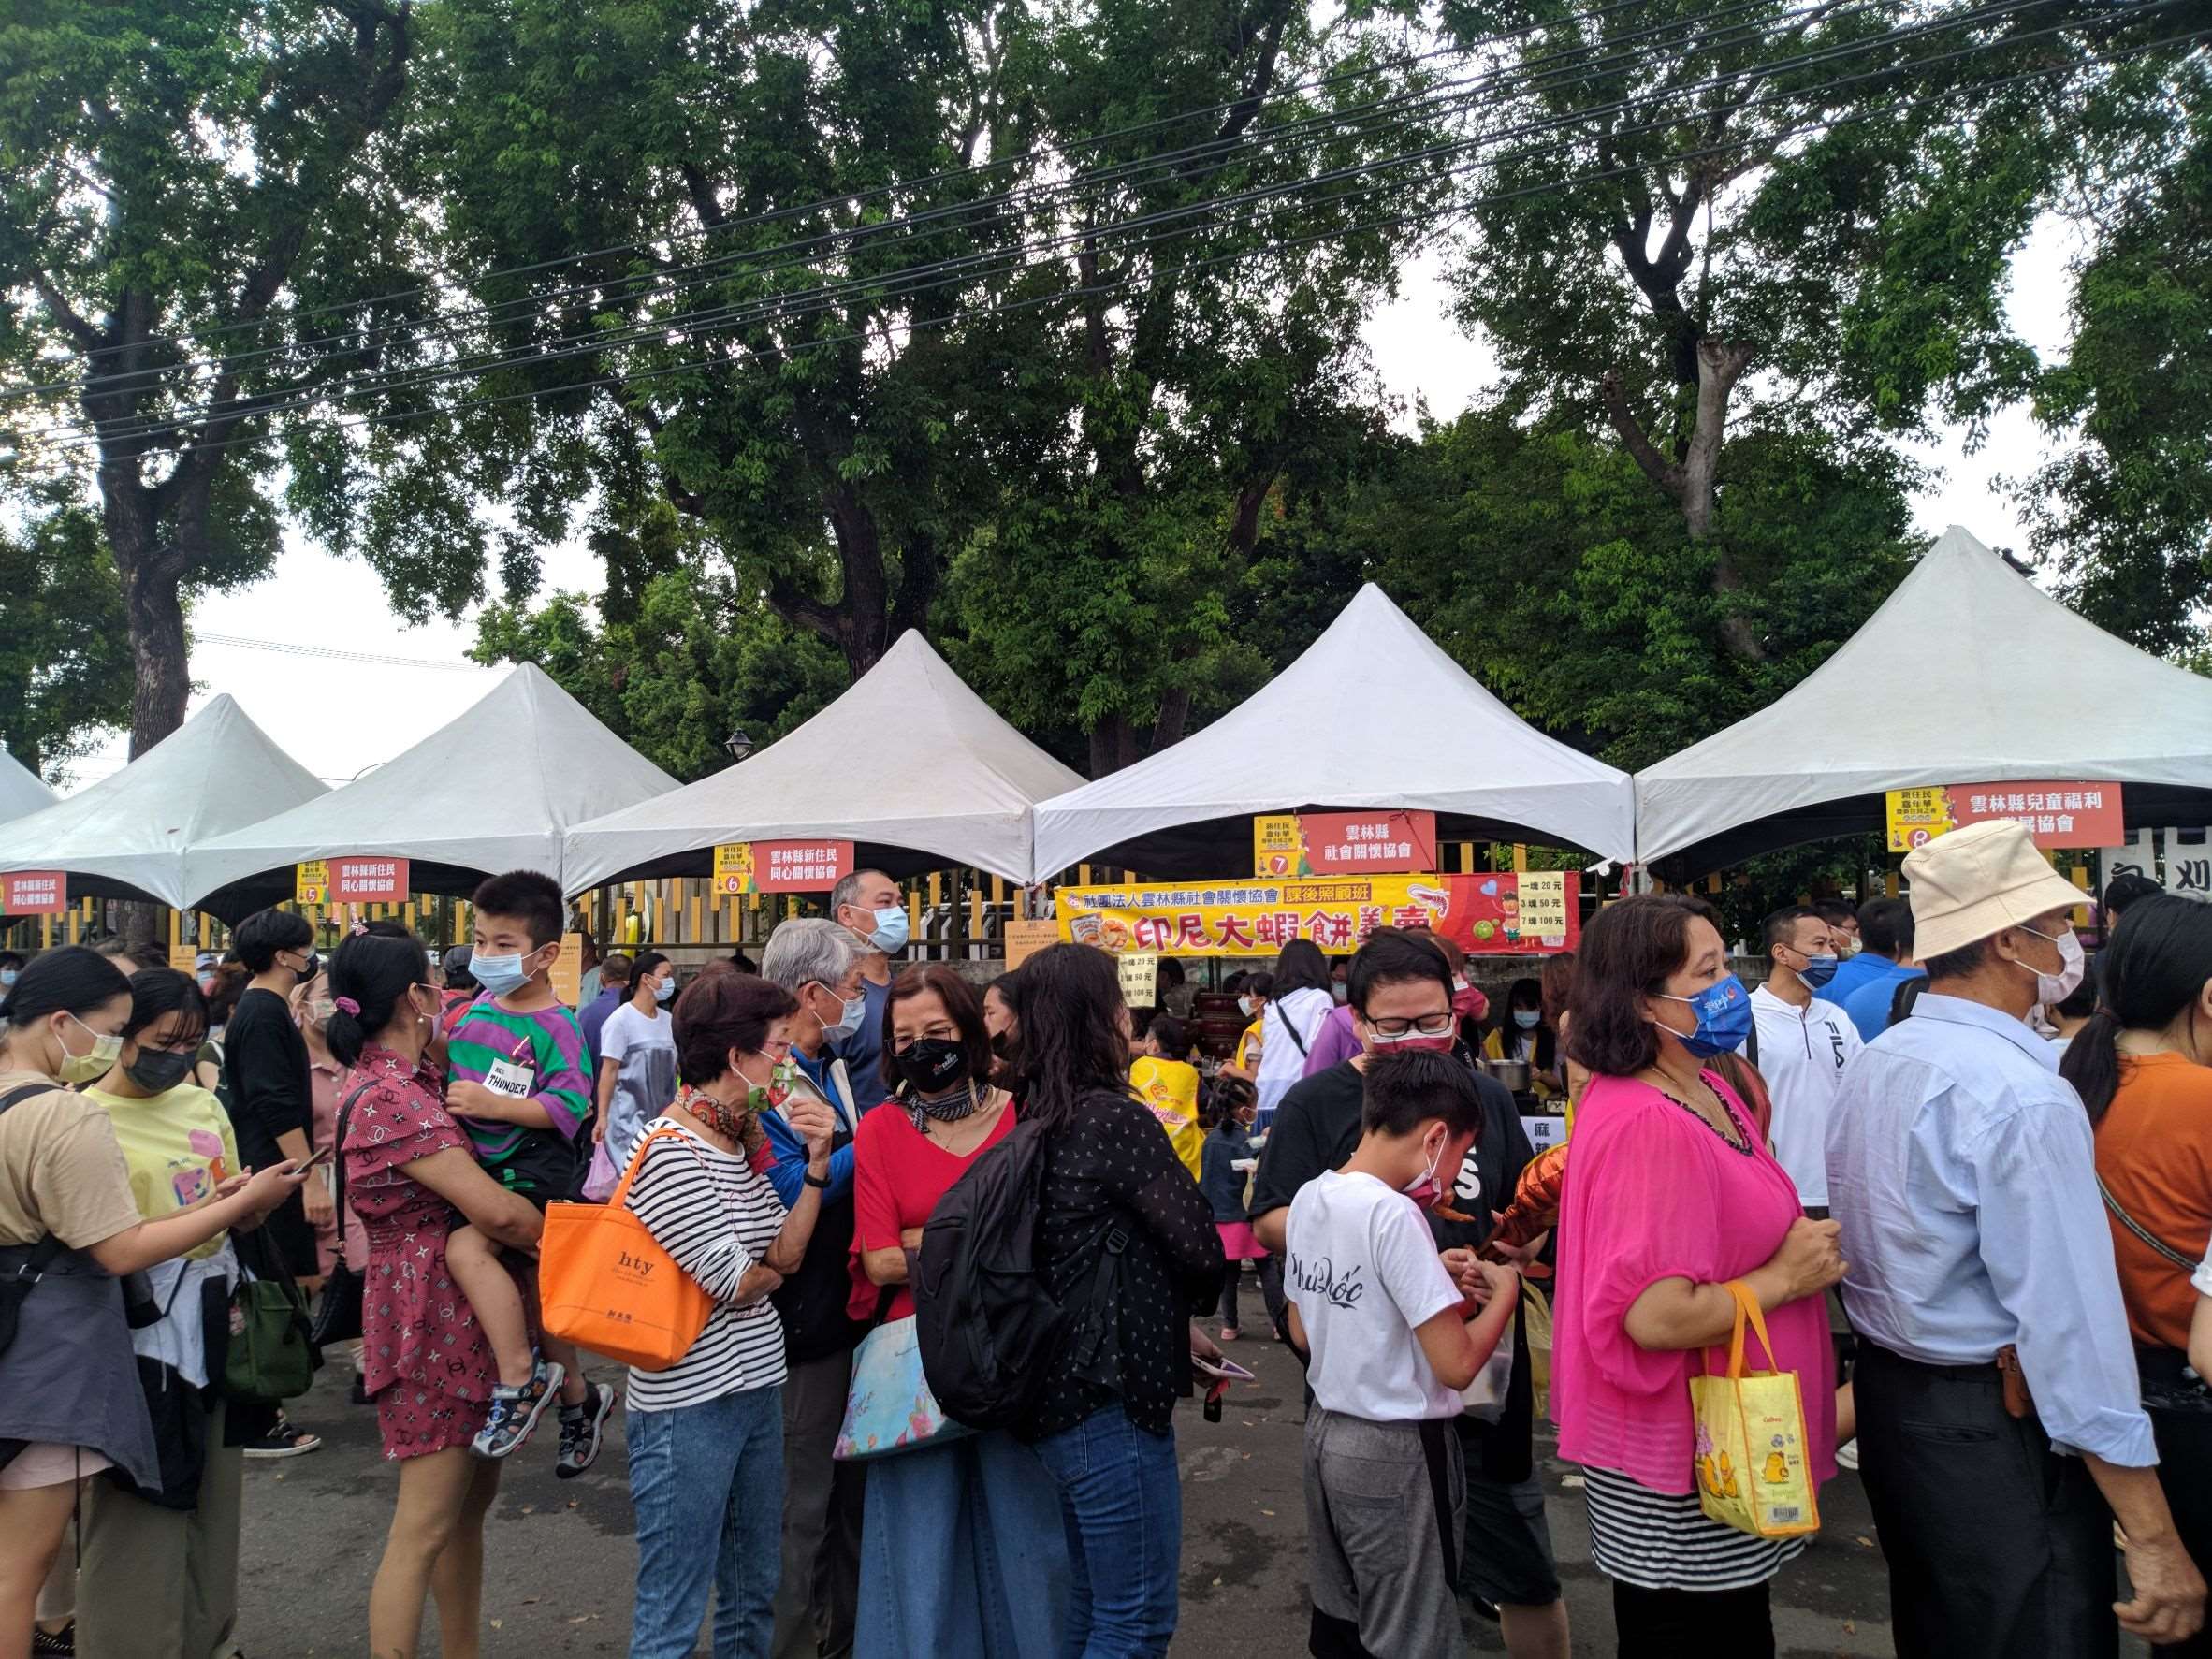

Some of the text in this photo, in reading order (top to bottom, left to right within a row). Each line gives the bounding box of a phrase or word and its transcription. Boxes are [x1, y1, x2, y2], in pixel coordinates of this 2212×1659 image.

[1970, 792, 2103, 813] 雲林縣兒童福利
[1346, 823, 1390, 841] 雲林縣
[2000, 814, 2074, 833] 展協會
[1914, 830, 1928, 848] 8
[770, 848, 837, 865] 雲林縣新住民
[1324, 842, 1411, 861] 社會關懷協會
[342, 864, 395, 878] 雲林縣新住民
[1274, 856, 1286, 873] 7
[770, 866, 837, 881] 同心關懷協會
[341, 879, 395, 893] 同心關懷協會
[728, 877, 738, 891] 6
[1541, 881, 1551, 890] 20
[1553, 881, 1563, 890] 元
[308, 889, 315, 901] 5
[1084, 888, 1279, 910] 社團法人雲林縣社會關懷協會
[1285, 884, 1370, 902] 課後照顧班
[1539, 898, 1550, 907] 50
[1551, 898, 1562, 908] 元
[1539, 916, 1553, 925] 100
[1554, 916, 1564, 925] 元
[1824, 1021, 1844, 1069] FILA
[488, 1074, 528, 1096] THUNDER
[618, 1251, 654, 1275] hty
